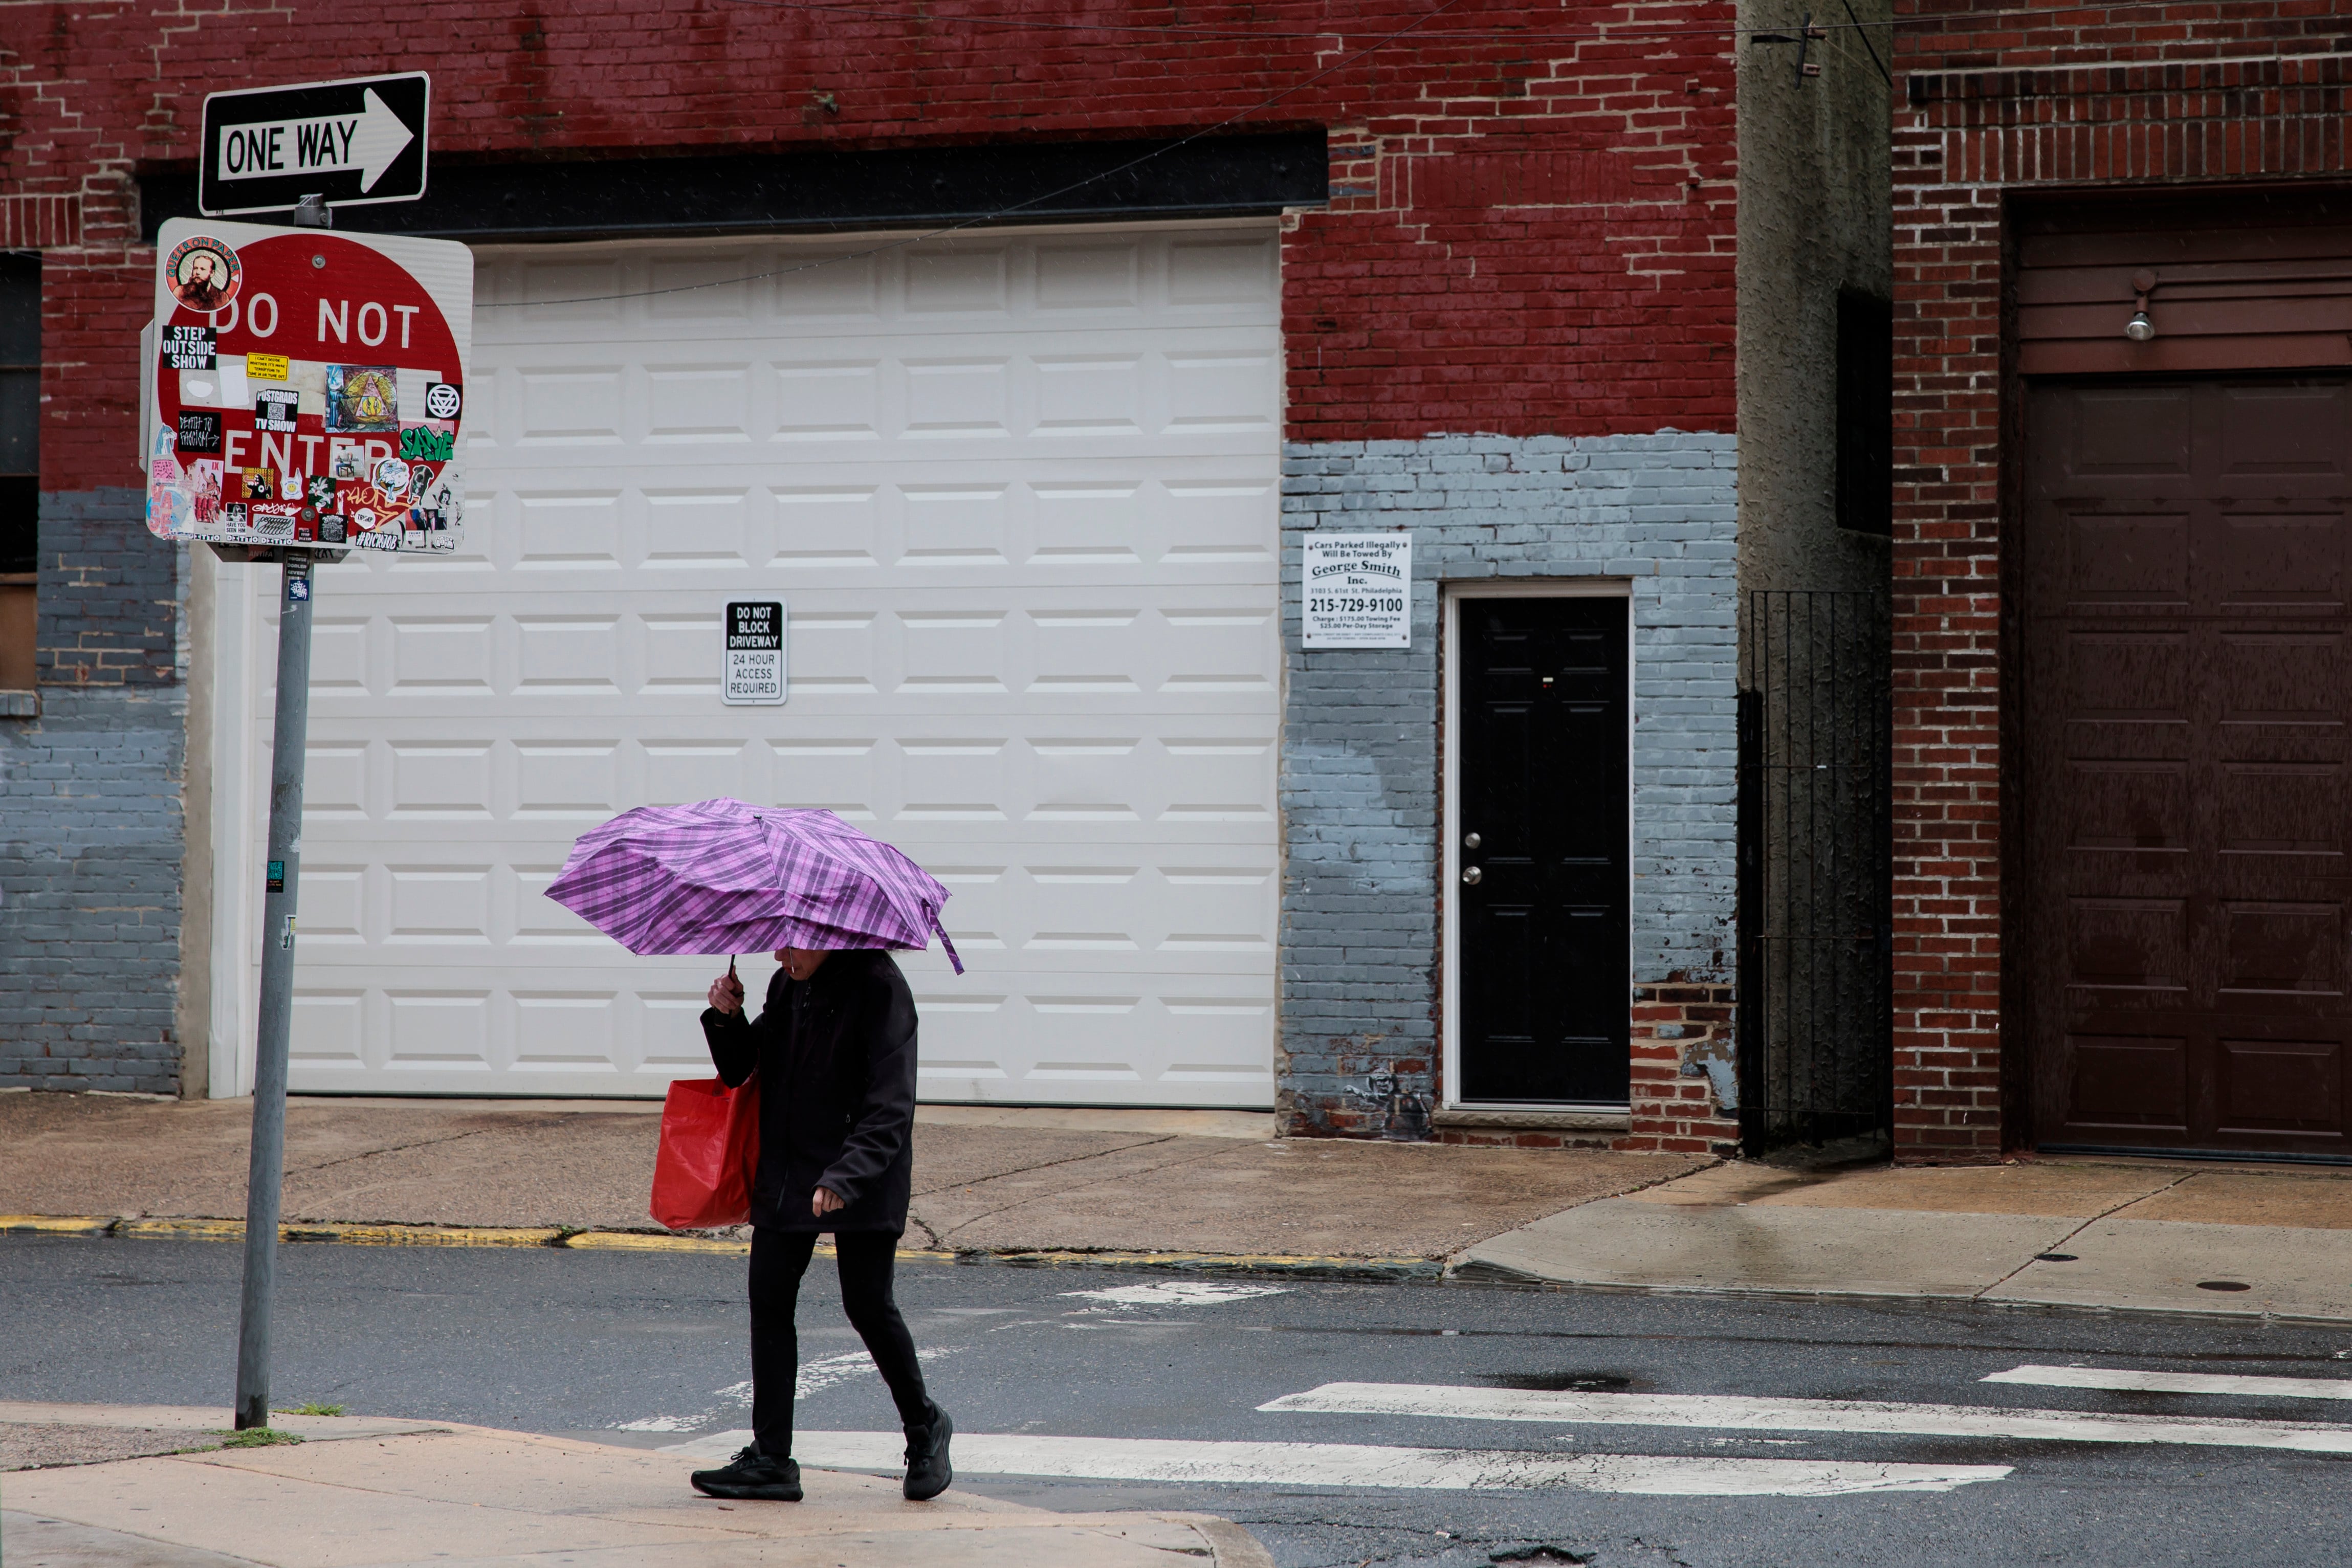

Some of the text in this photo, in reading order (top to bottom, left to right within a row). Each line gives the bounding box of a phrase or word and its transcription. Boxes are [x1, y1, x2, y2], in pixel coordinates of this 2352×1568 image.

[226, 120, 358, 174] ONE WAY
[166, 237, 239, 278] QUEER ON PAPER
[209, 293, 420, 348] DO NOT
[173, 326, 206, 341] STEP
[163, 340, 216, 356] OUTSIDE
[171, 354, 207, 369] SHOW
[257, 389, 298, 405] POSTGRADS
[179, 416, 213, 432] DEATH TO
[255, 417, 297, 433] TV SHOW
[211, 462, 219, 471] IX
[357, 514, 373, 523] TRUMP
[1366, 541, 1400, 550] Illegally
[1312, 560, 1401, 577] George Smith
[1347, 576, 1368, 585] Inc.
[1310, 599, 1403, 611] 215-729-9100
[737, 607, 772, 619] DO NOT
[738, 621, 770, 633] BLOCK
[730, 635, 778, 648] DRIVEWAY
[733, 654, 775, 665] 24 HOUR
[735, 669, 772, 679] ACCESS
[730, 682, 777, 694] REQUIRED
